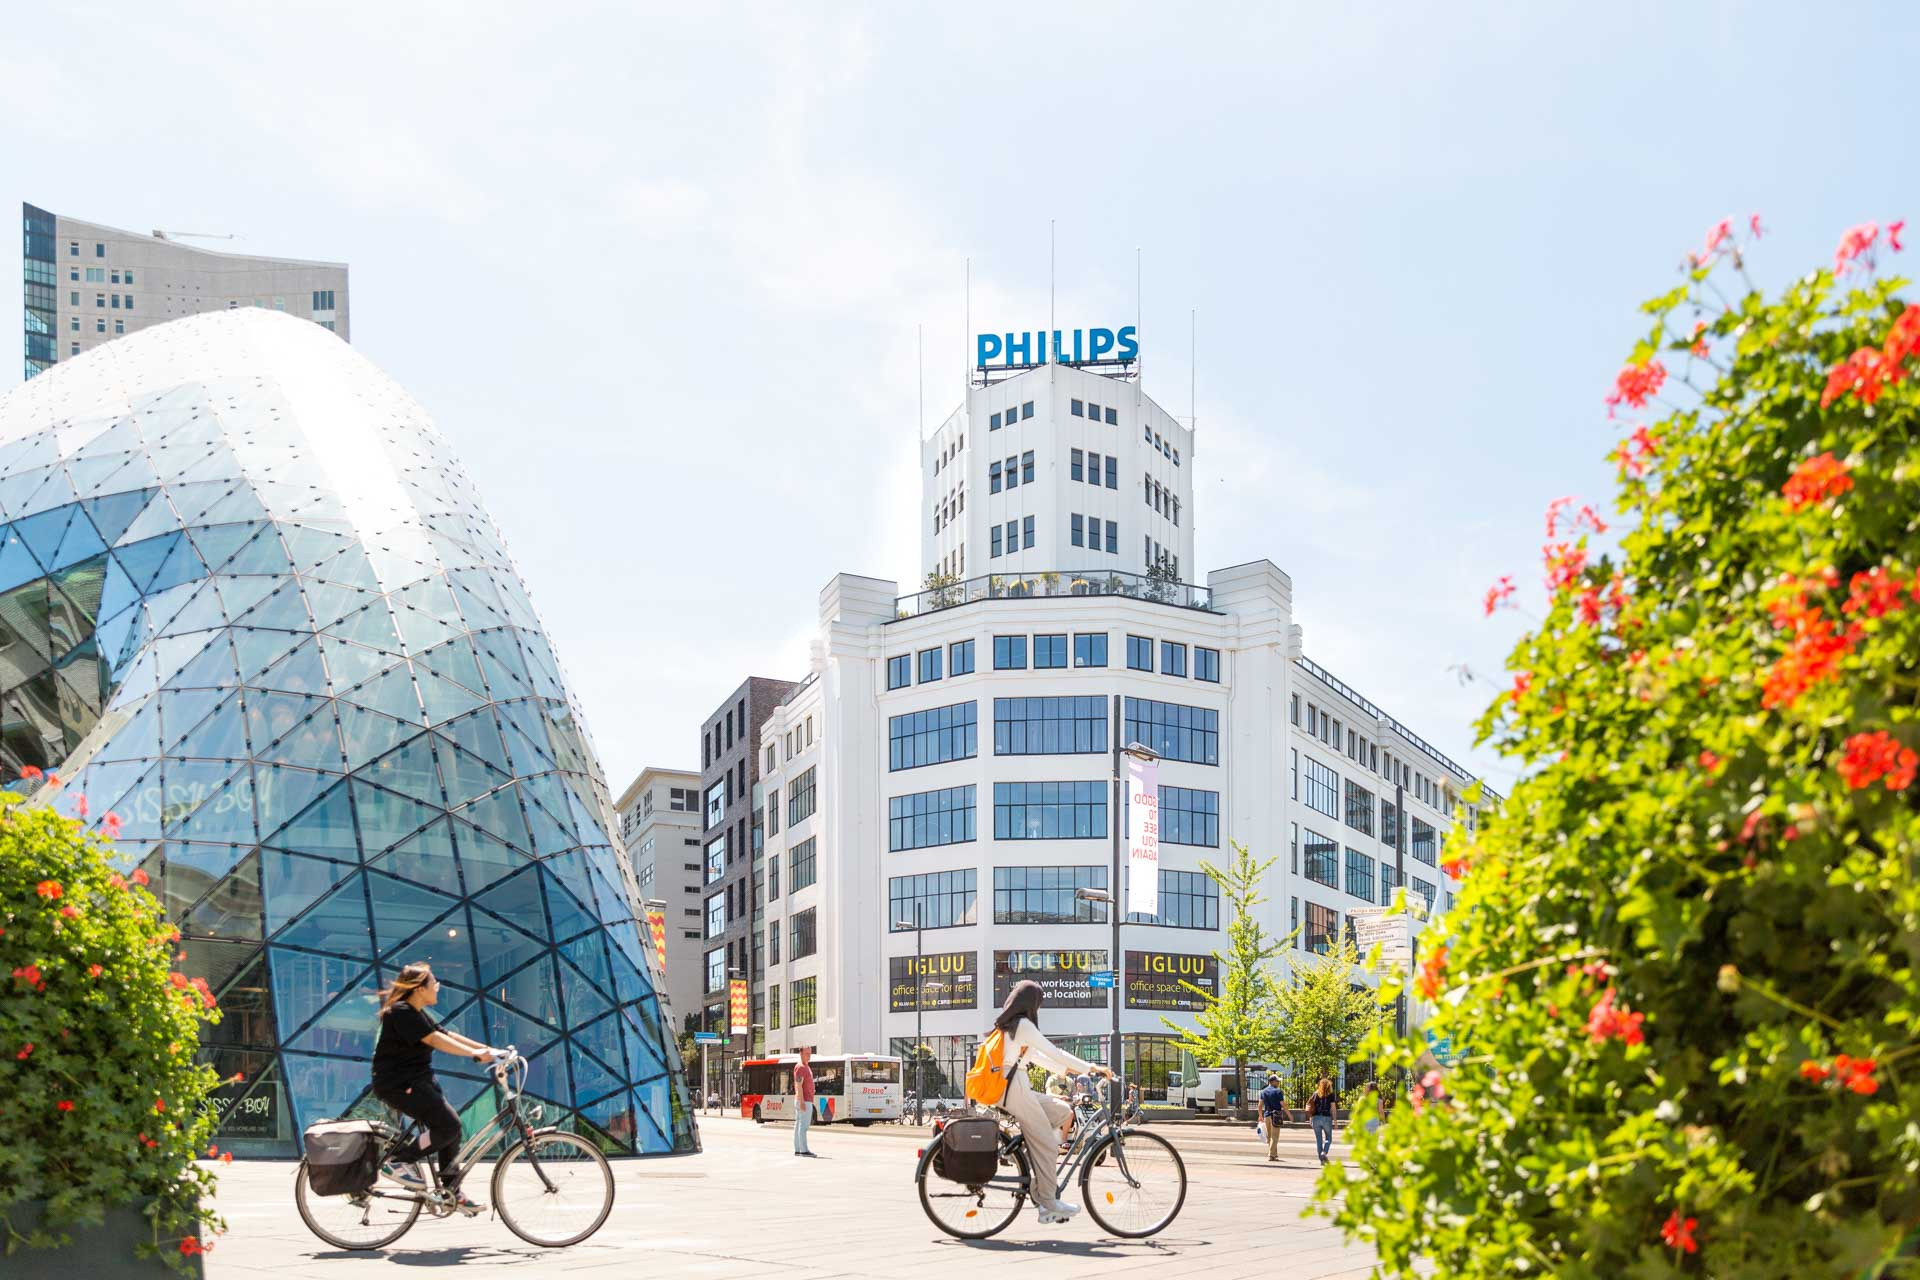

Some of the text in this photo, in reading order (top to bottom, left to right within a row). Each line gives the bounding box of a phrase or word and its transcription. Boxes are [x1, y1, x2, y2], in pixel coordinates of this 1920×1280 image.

[977, 326, 1139, 366] PHILIPS
[908, 955, 964, 975] IGLUU
[1018, 952, 1089, 971] IGLUU
[1144, 955, 1204, 974] IGLUU
[892, 984, 915, 996] office
[955, 983, 972, 993] rent
[1054, 990, 1092, 999] location
[1130, 980, 1155, 991] office
[1156, 983, 1181, 995] space
[767, 1100, 782, 1110] Bravo
